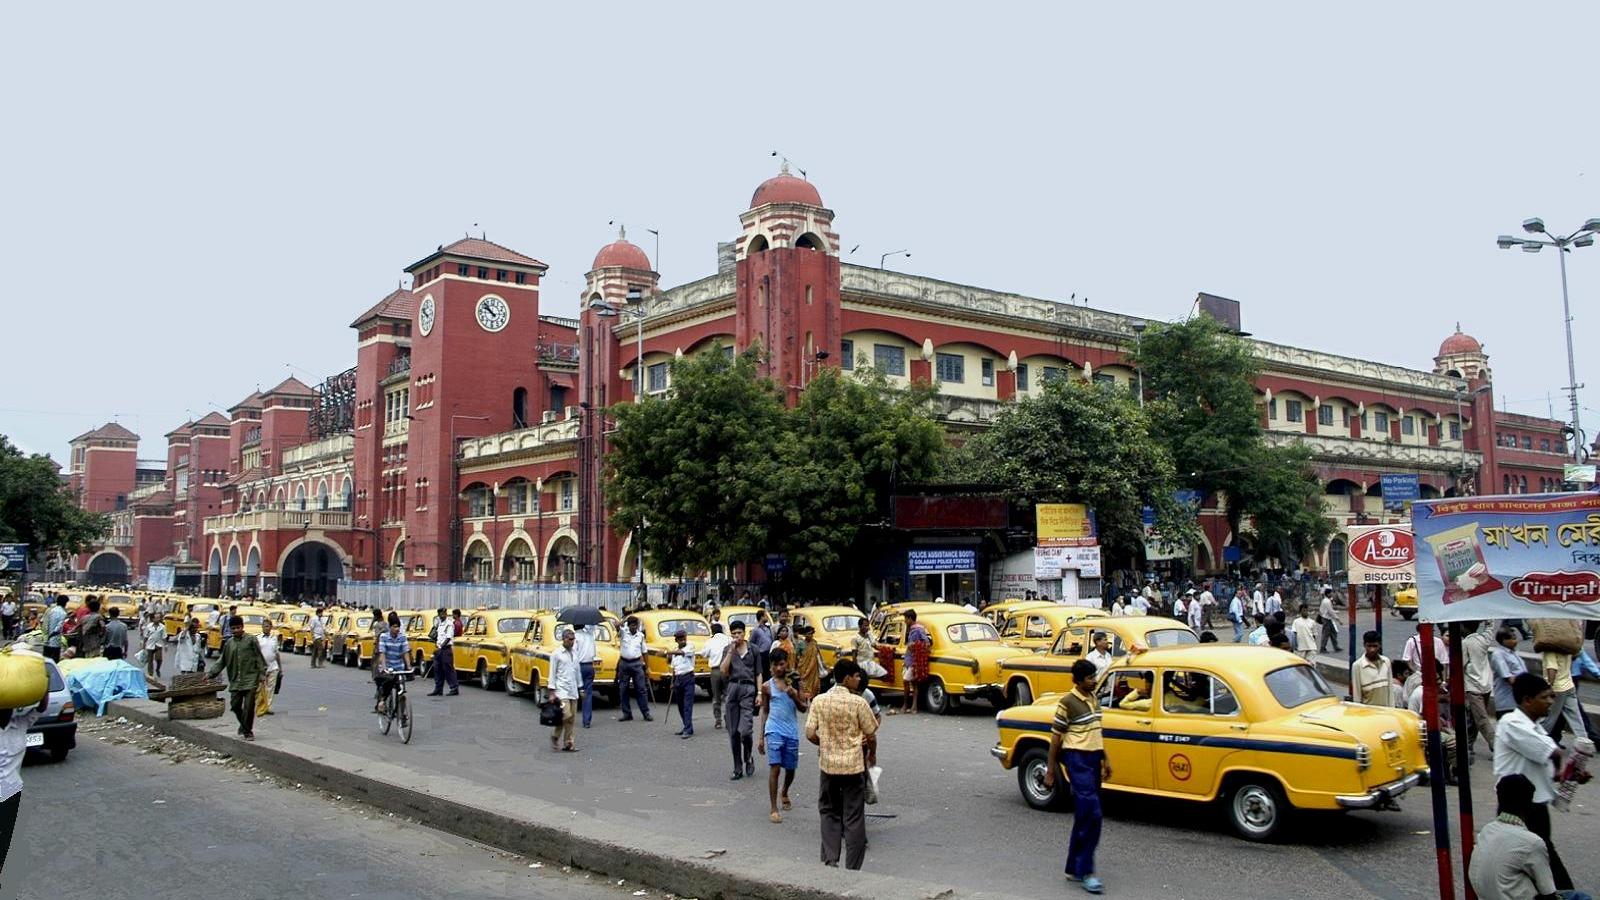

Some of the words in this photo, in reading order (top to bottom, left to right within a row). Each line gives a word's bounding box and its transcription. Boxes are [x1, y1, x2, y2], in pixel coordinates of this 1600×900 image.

[1482, 522, 1549, 550] মাখন
[908, 551, 927, 559] POLICE
[958, 550, 975, 558] BOOTH
[1364, 572, 1412, 581] BISCUITS
